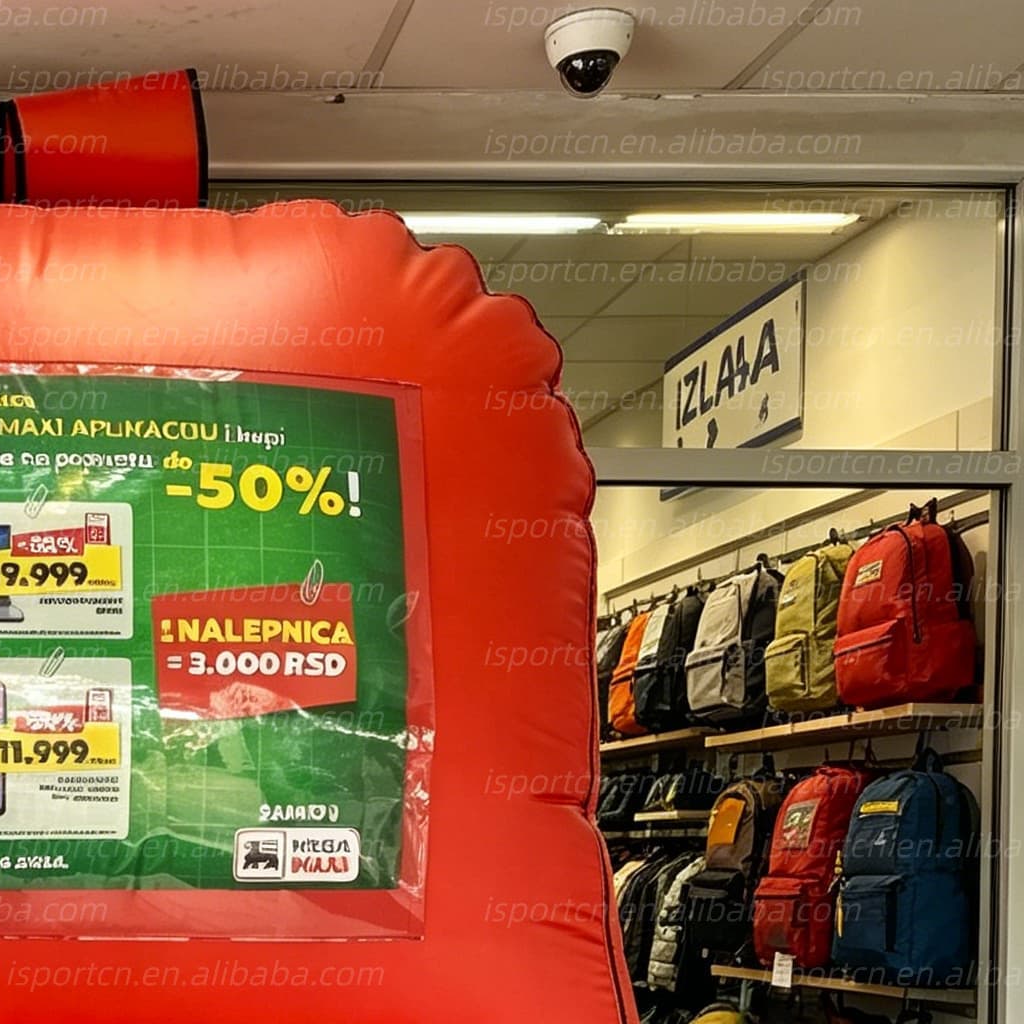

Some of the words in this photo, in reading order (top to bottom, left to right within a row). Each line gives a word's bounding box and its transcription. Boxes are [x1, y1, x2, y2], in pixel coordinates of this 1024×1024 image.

[178, 617, 355, 645] NALEPNICA
[188, 651, 281, 676] 3.000
[284, 652, 347, 677] RSD
